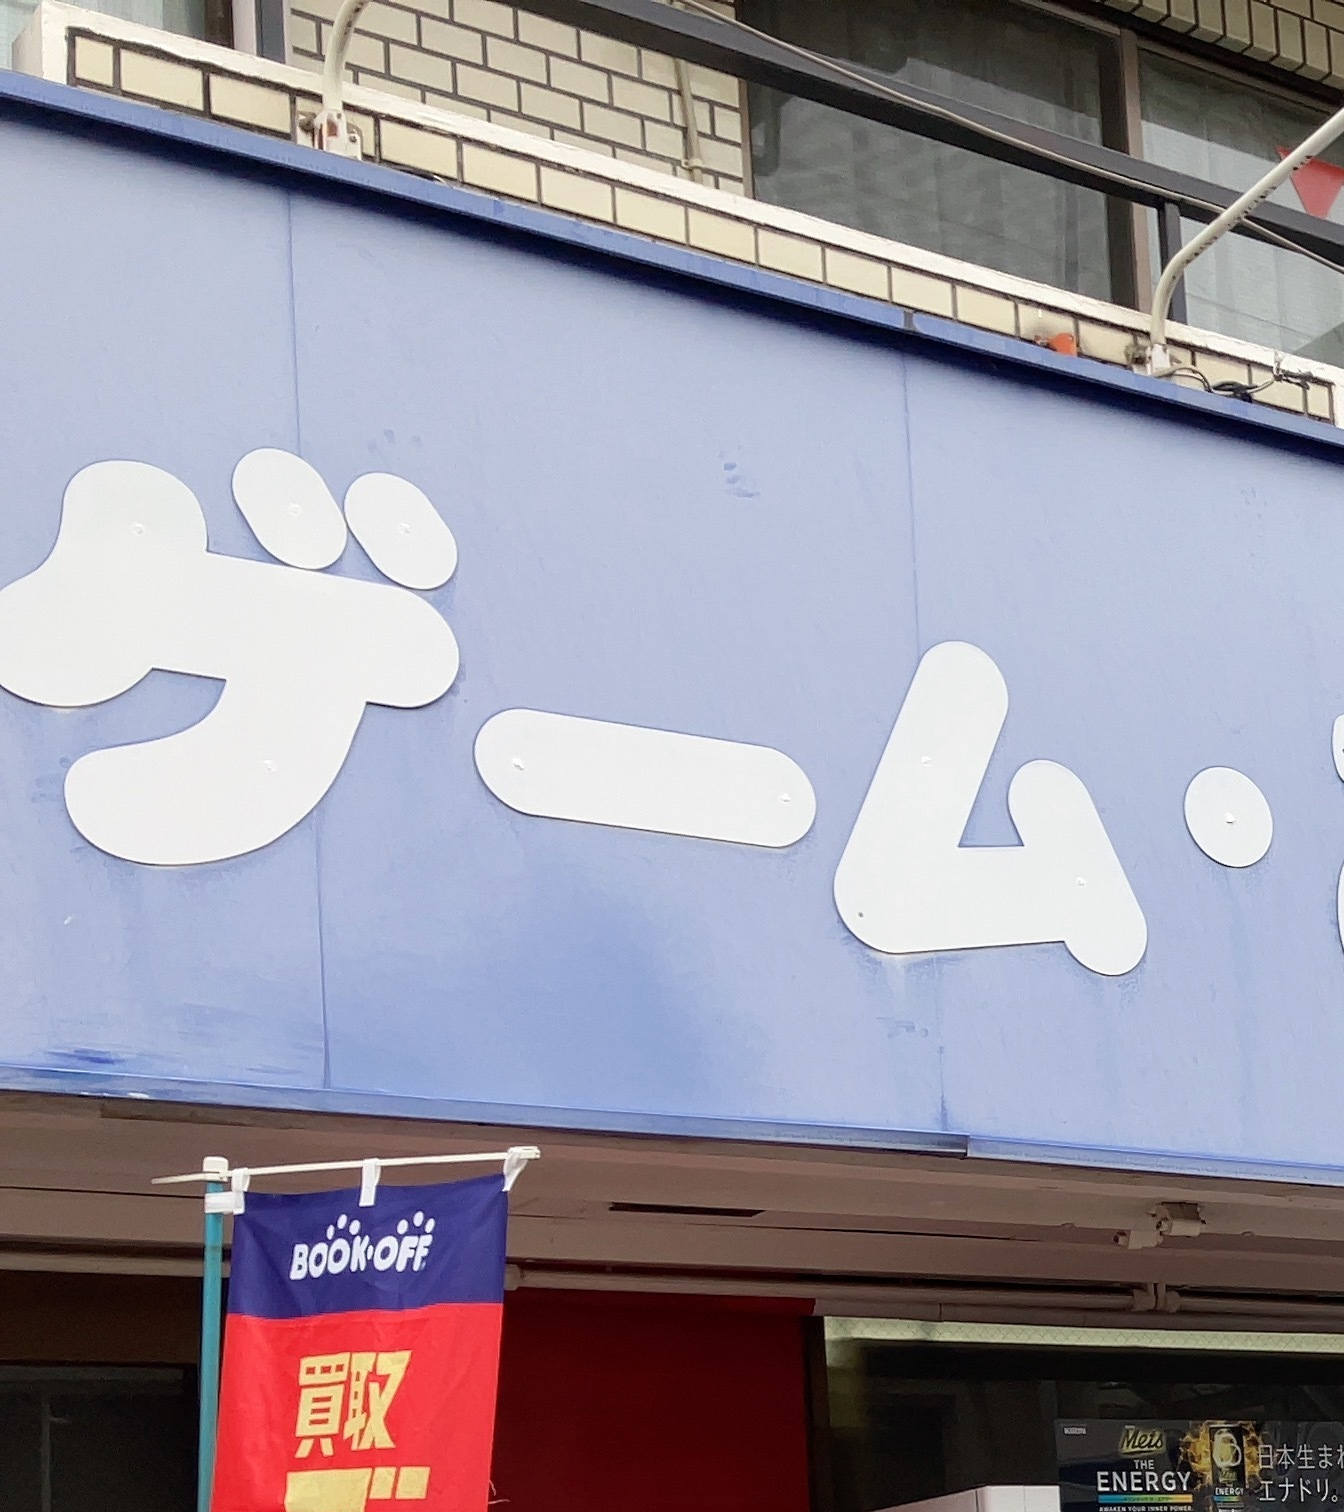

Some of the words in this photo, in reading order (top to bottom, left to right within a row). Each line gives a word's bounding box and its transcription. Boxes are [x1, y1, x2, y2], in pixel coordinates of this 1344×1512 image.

[295, 1350, 413, 1458] 買取
[1134, 1459, 1155, 1470] THE
[1097, 1471, 1192, 1492] ENERGY
